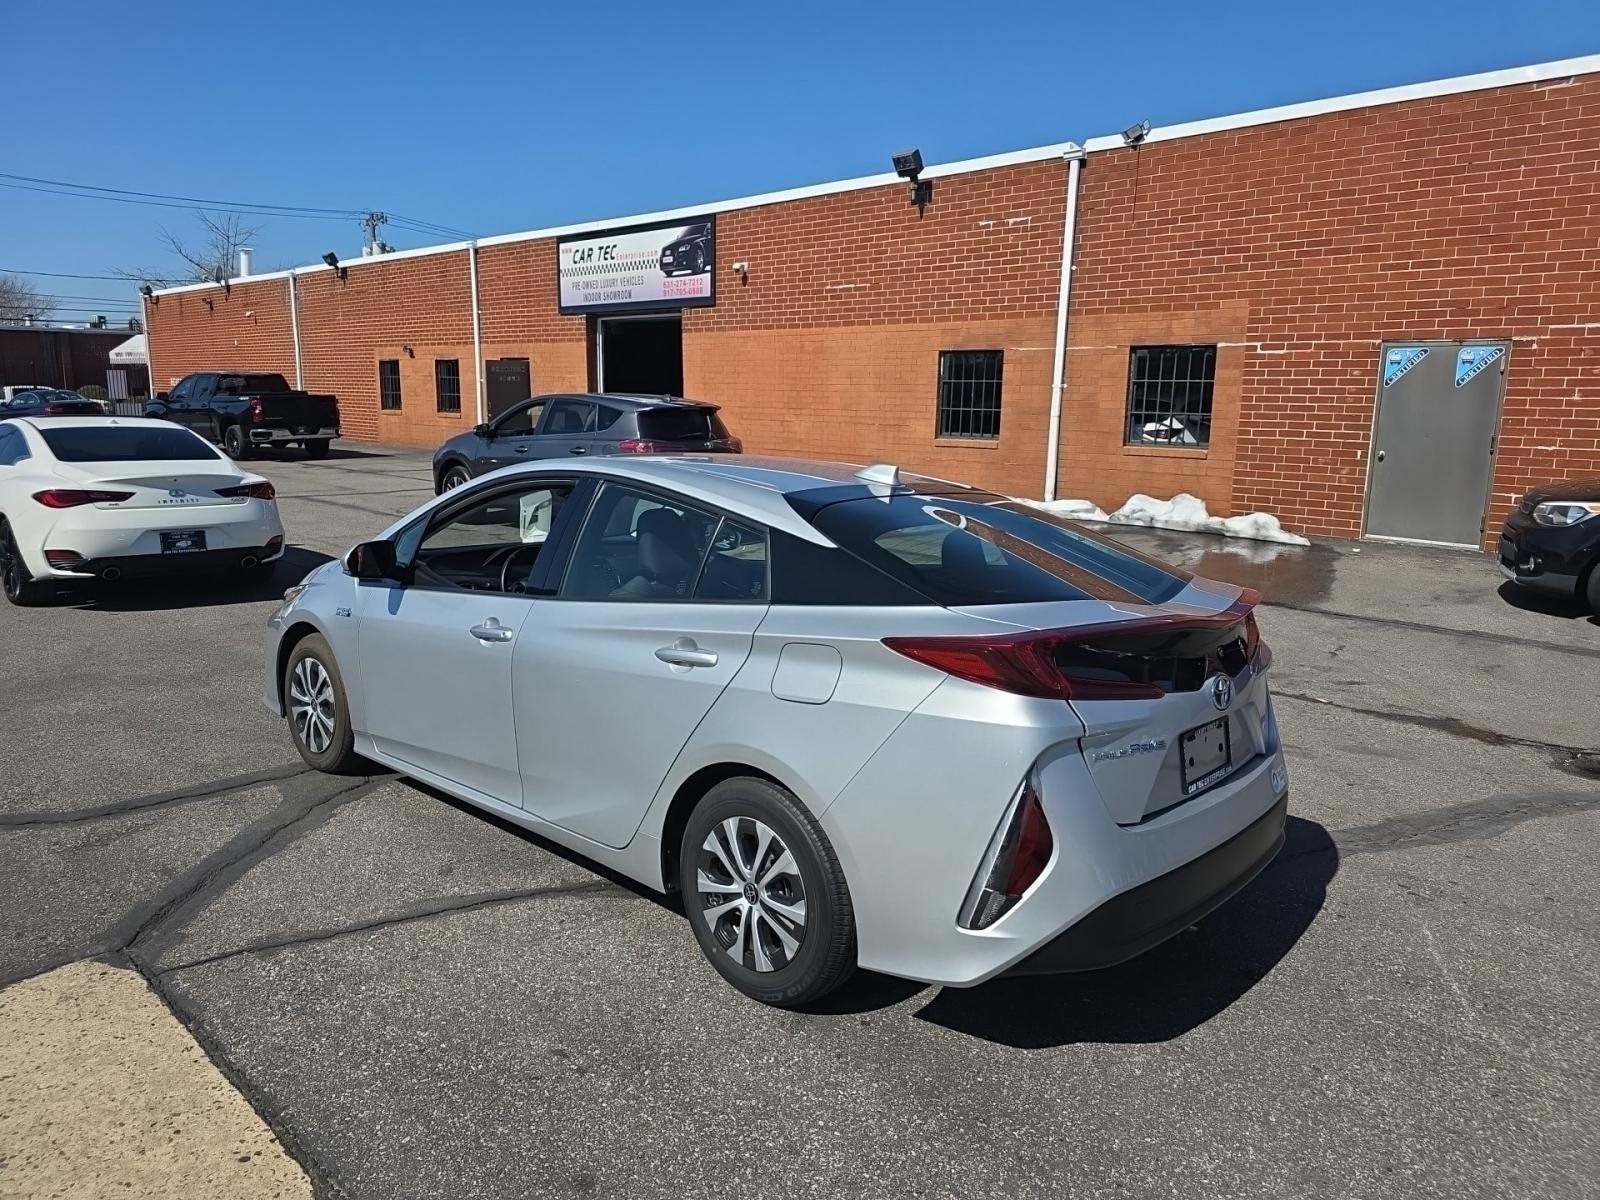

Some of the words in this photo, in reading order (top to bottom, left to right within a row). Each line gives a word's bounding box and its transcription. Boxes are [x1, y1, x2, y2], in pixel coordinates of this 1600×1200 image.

[573, 247, 594, 264] CAR
[597, 244, 617, 261] TEC
[600, 278, 619, 289] LUXURY
[620, 275, 644, 287] VEHICLES
[583, 292, 601, 302] INDOOR
[602, 289, 632, 301] SHOWROOM
[1387, 350, 1426, 384] CERTIFIED
[1458, 350, 1501, 384] CERTIFIED
